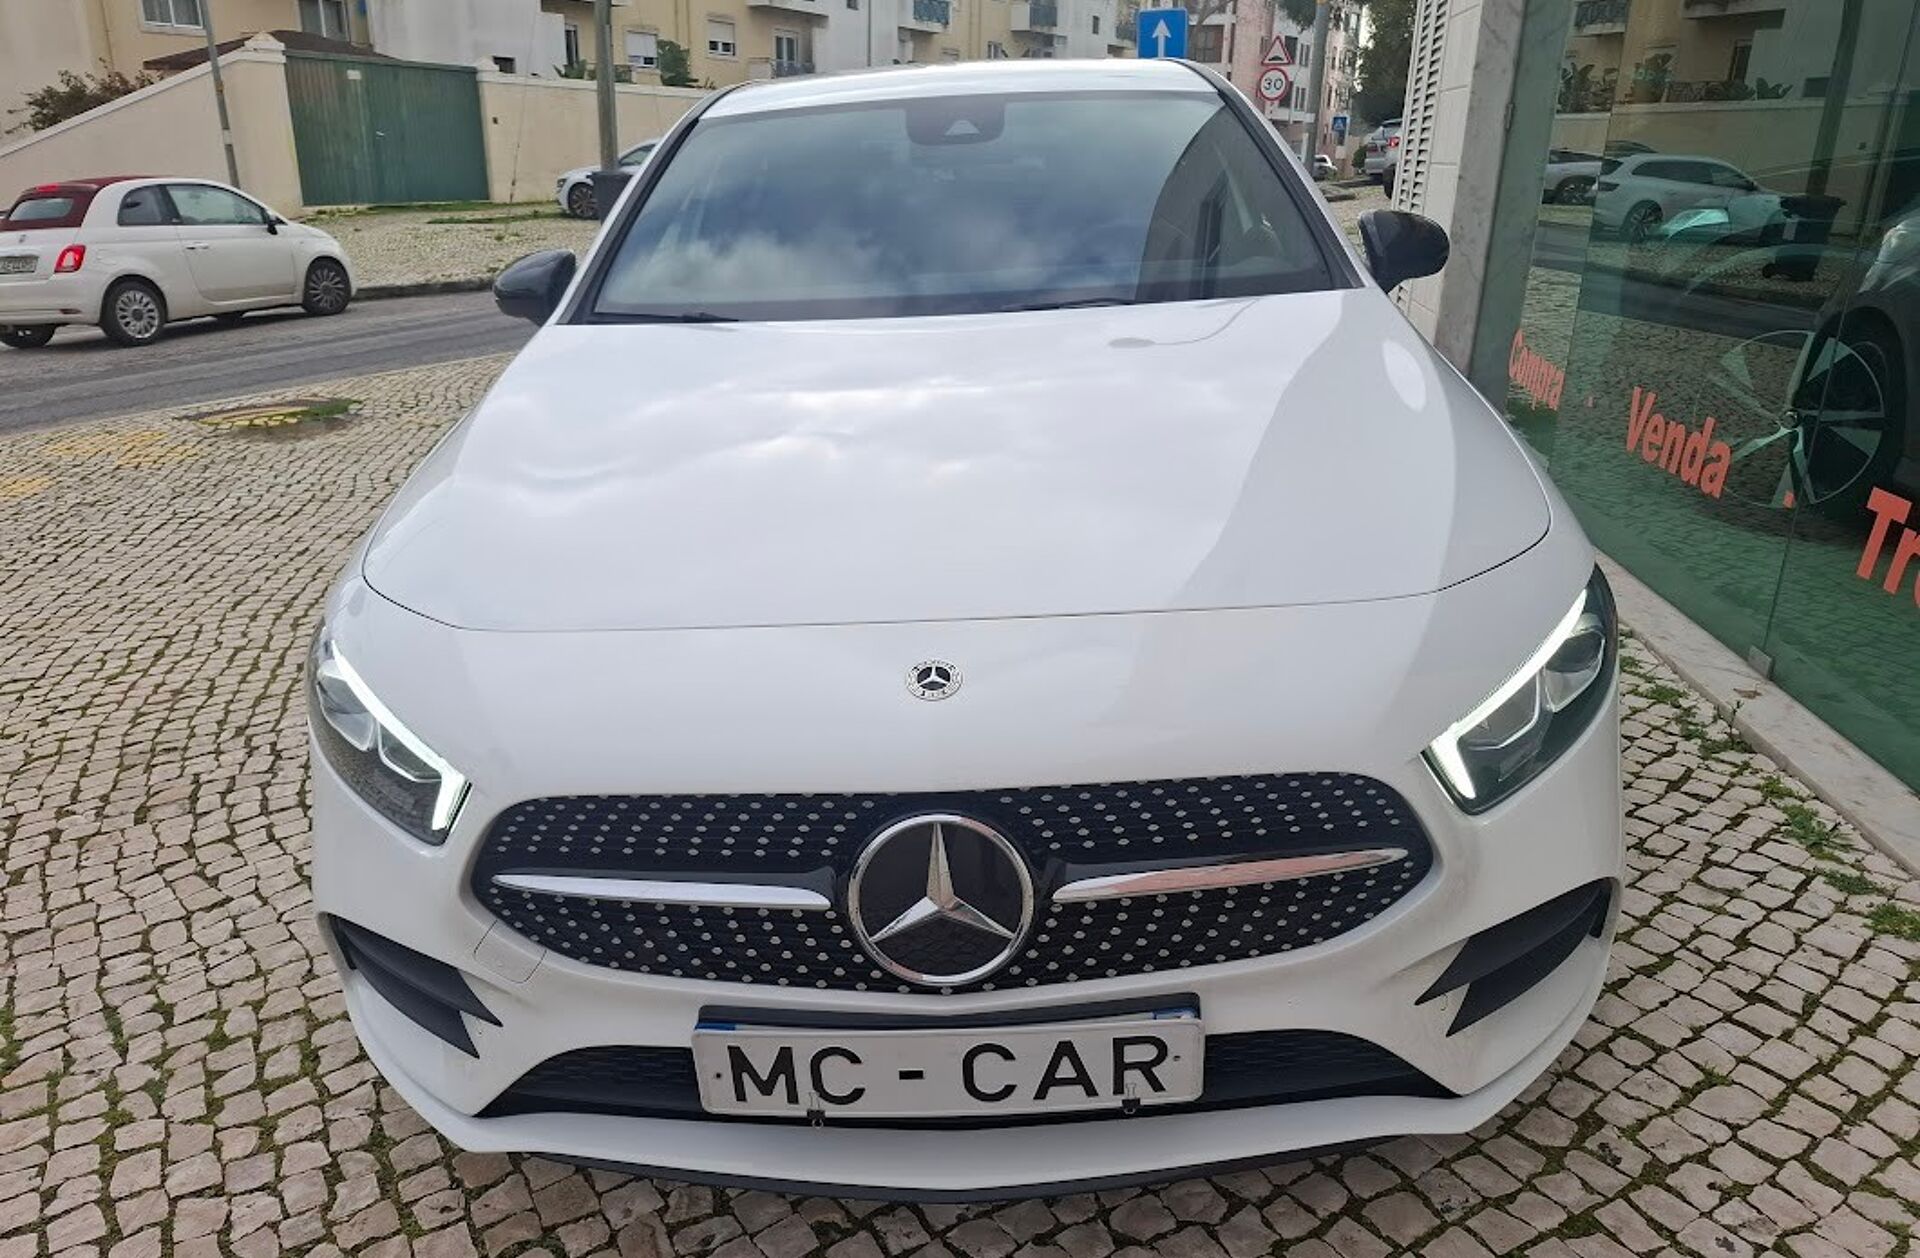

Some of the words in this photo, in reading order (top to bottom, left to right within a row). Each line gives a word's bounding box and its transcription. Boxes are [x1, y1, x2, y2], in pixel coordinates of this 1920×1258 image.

[1263, 78, 1284, 91] 30
[1508, 329, 1565, 411] Compra
[1626, 386, 1733, 499] Venda
[726, 1044, 866, 1106] MC
[961, 1035, 1170, 1103] CAR
